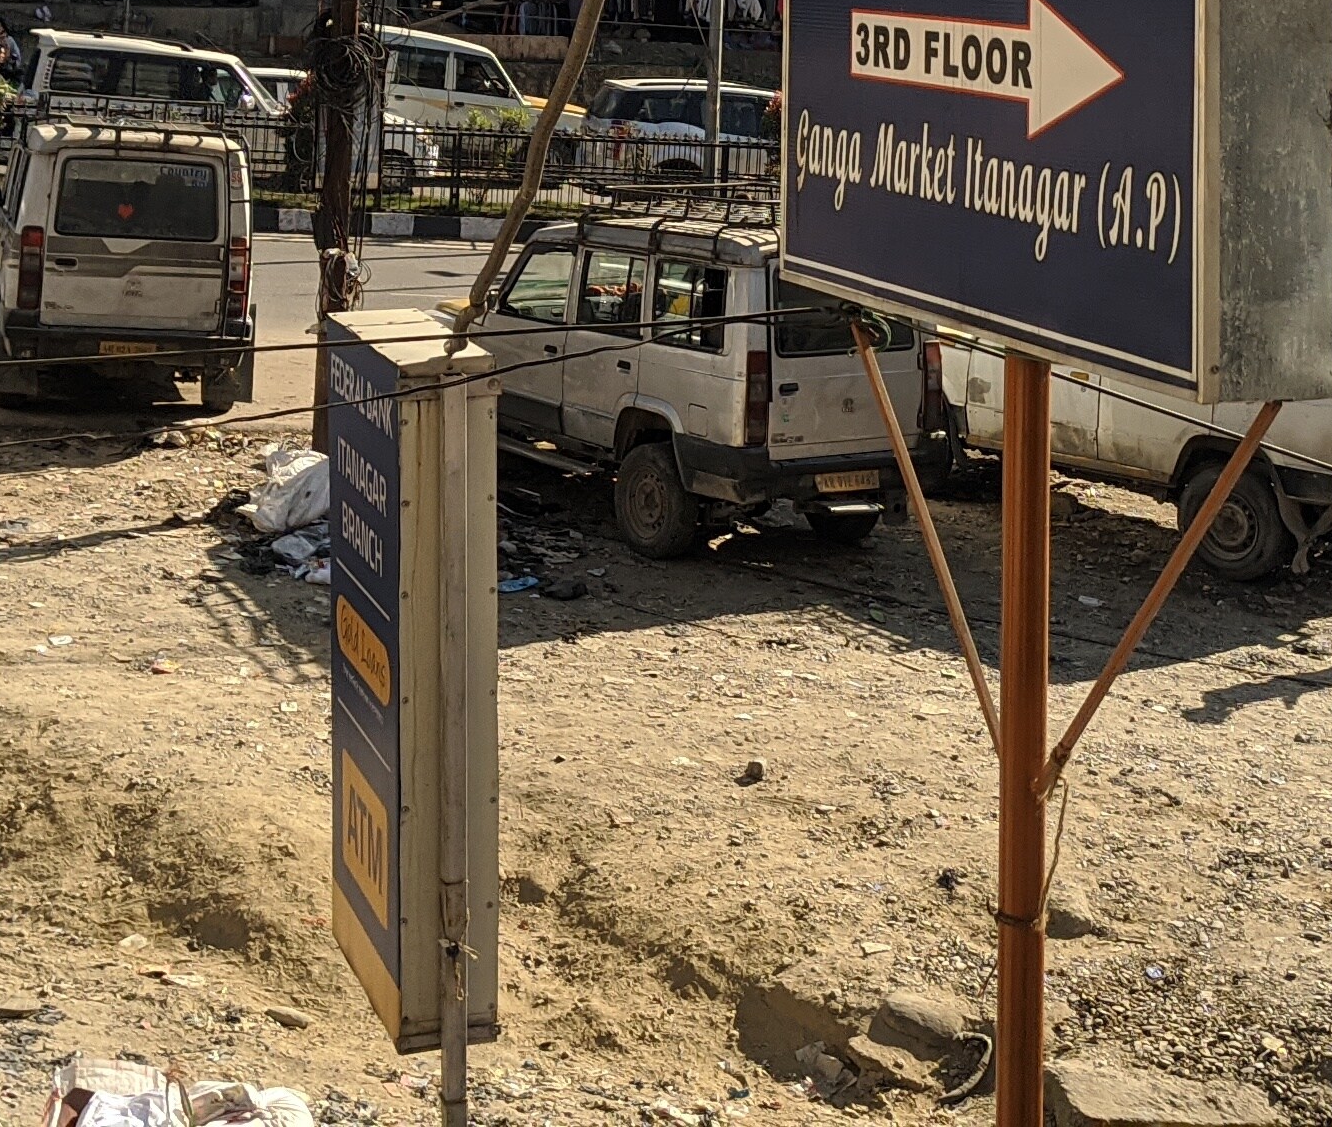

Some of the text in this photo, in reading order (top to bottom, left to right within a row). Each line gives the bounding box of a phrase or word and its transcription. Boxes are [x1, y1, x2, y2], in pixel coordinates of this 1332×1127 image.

[855, 22, 1033, 89] 3RD FLOOR
[795, 109, 1182, 265] Ganga Market Itanagar (A.P)
[330, 351, 393, 440] FEDERAL BANK
[337, 435, 387, 518] ITANAGAR
[341, 500, 383, 578] BRANCH
[341, 604, 359, 656] Gold
[361, 631, 386, 689] Loans
[347, 784, 383, 896] ATM
